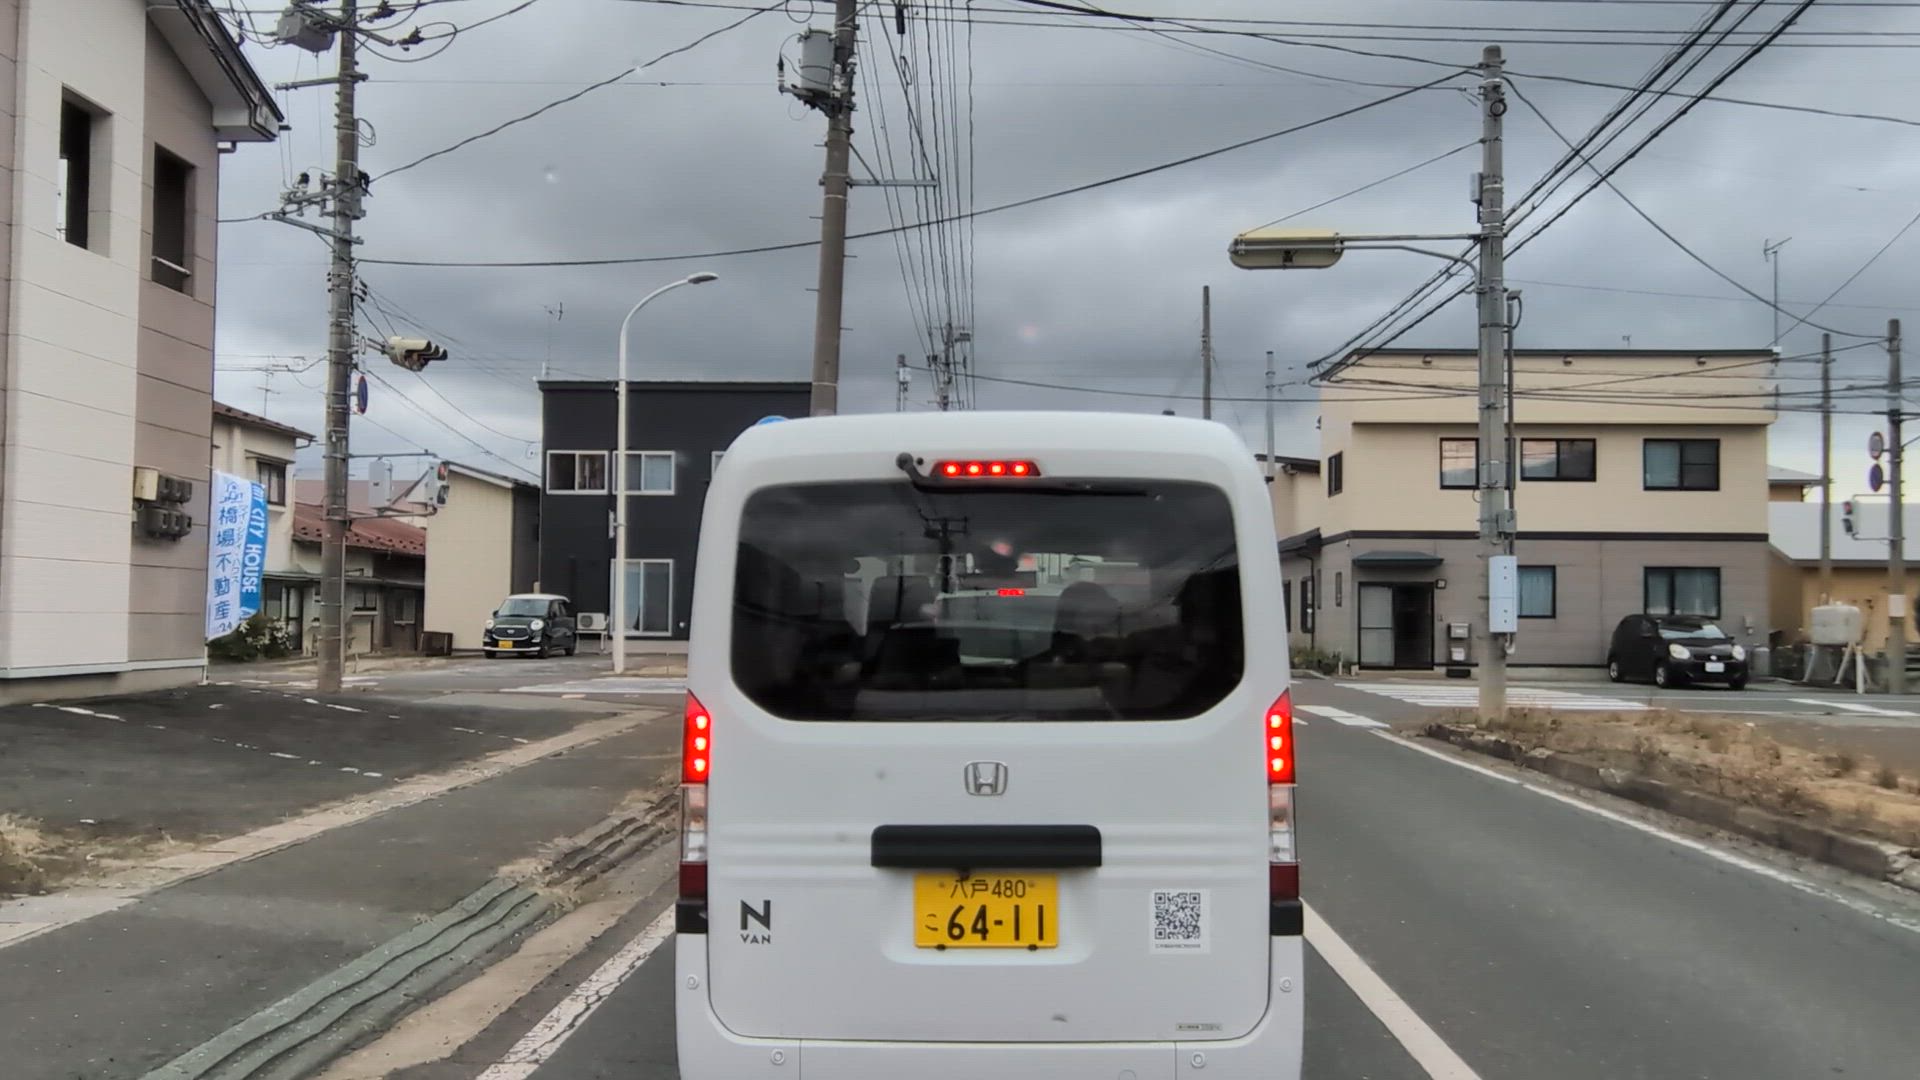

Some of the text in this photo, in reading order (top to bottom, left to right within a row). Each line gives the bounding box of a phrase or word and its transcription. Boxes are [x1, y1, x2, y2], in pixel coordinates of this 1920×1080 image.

[249, 508, 265, 538] CITY
[213, 507, 238, 621] 橋場不動産
[242, 544, 263, 593] HOUSE
[740, 899, 771, 931] N
[947, 904, 1044, 941] 64-11
[740, 933, 771, 945] VAN
